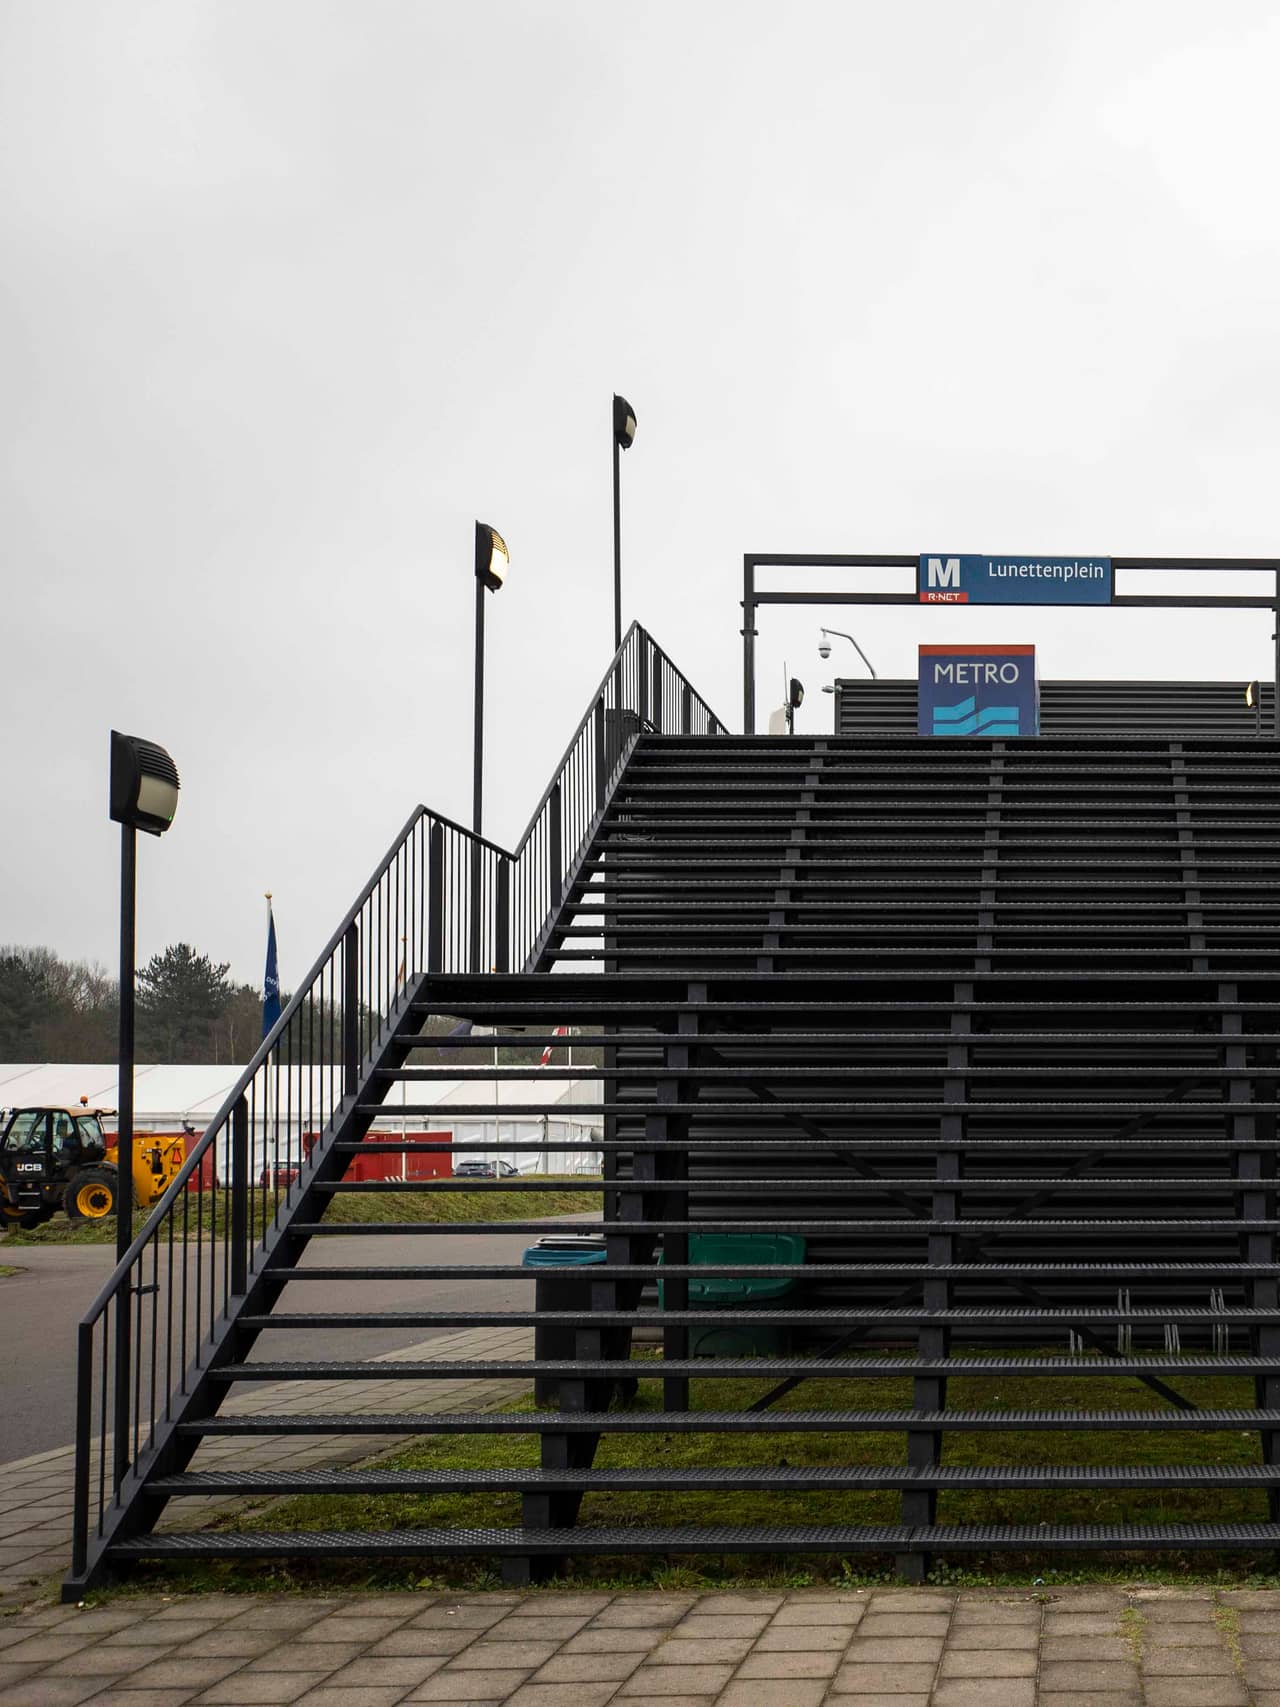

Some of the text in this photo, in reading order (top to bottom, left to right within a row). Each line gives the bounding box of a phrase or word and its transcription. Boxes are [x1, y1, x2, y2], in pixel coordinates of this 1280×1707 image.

[928, 558, 960, 587] M
[989, 561, 1104, 582] Lunettenplein
[934, 662, 1020, 684] METRO
[16, 1163, 42, 1171] JCB
